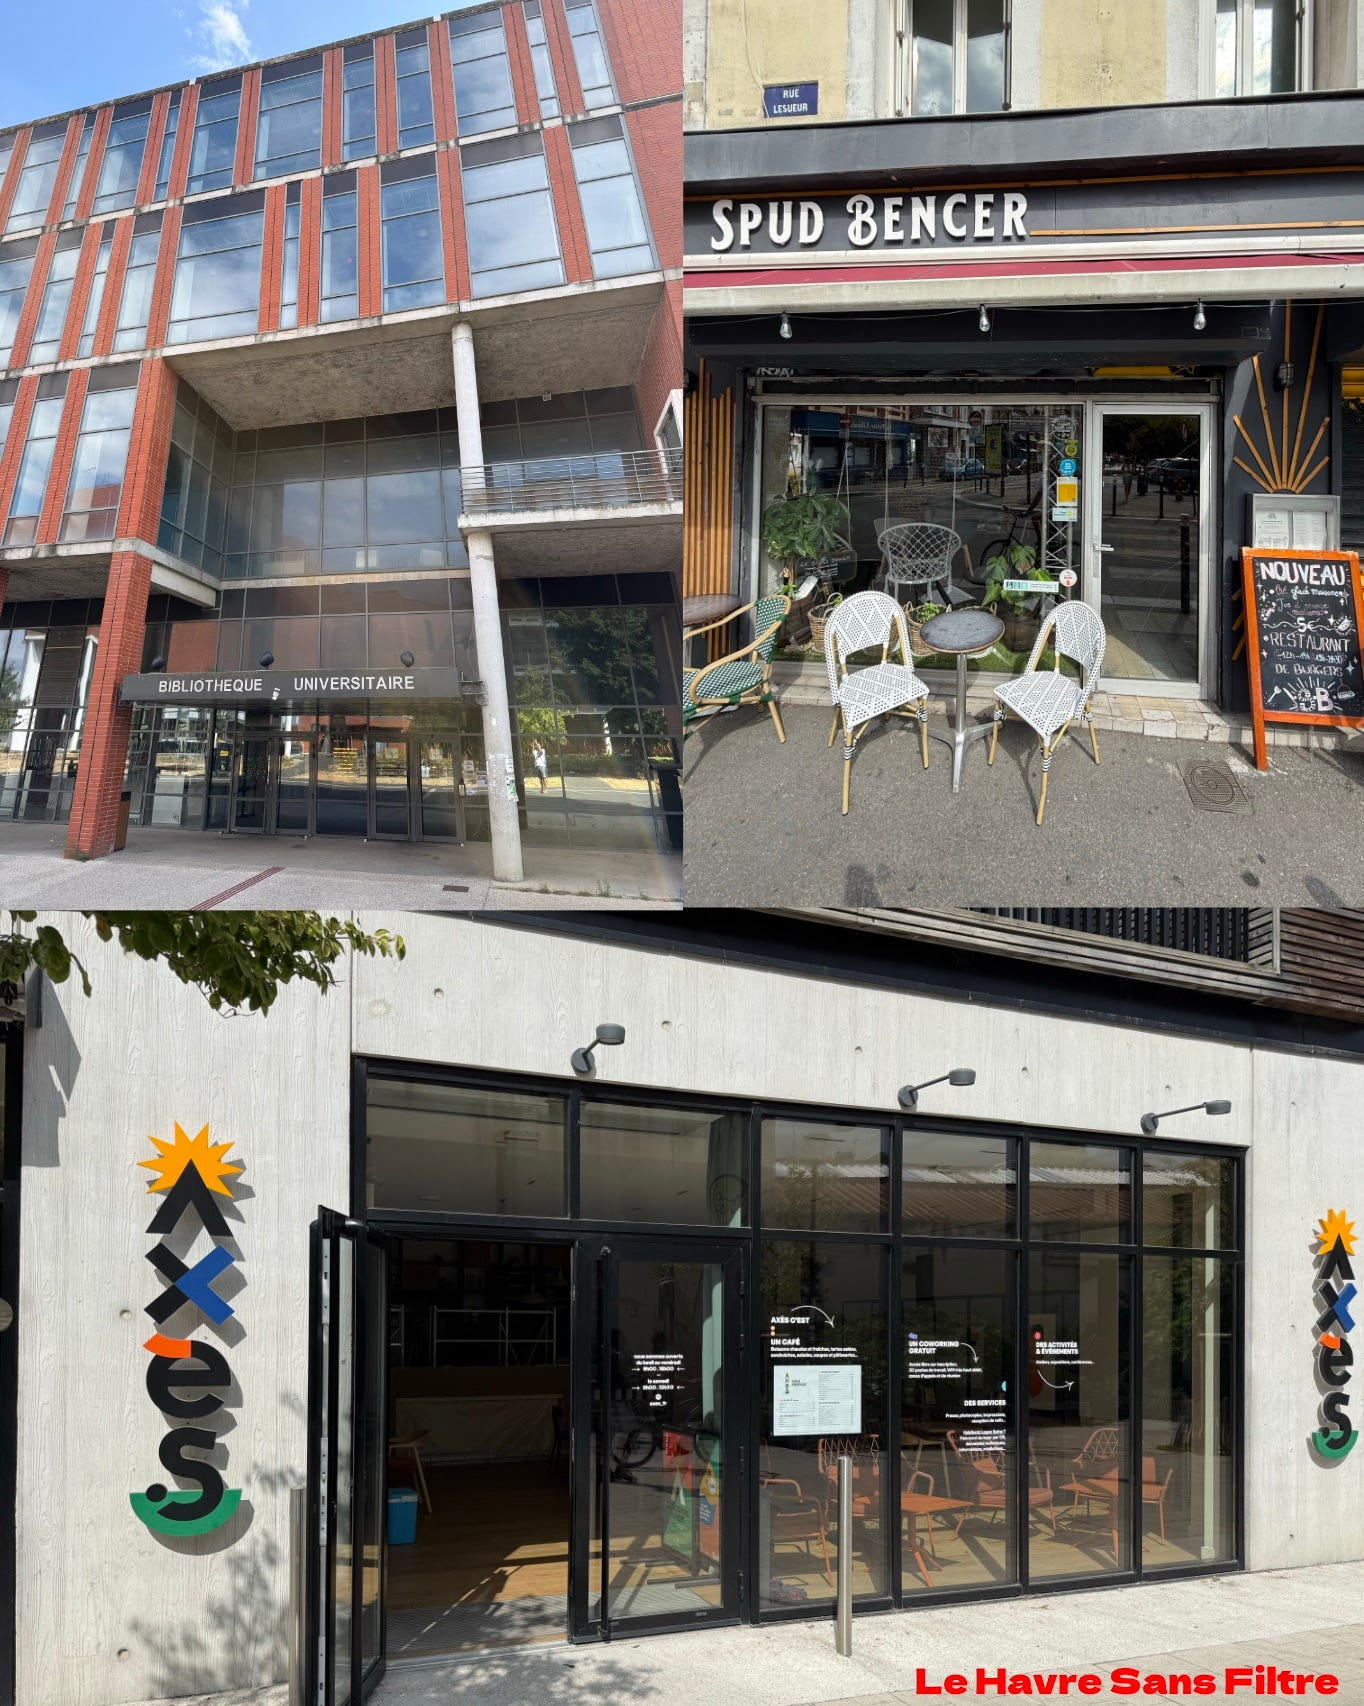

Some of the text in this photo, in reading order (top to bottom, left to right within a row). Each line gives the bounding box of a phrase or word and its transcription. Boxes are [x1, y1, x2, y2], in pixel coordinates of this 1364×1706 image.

[782, 89, 800, 98] RUE
[774, 103, 808, 114] LESUEUR
[711, 192, 1027, 251] SPUD BENCER
[1260, 562, 1345, 585] NOUVEAU
[1270, 632, 1351, 652] RESTAURANT
[1275, 663, 1343, 677] DE BURGERS
[158, 676, 414, 693] BIBLIOTHEQUE UNIVERSITAIRE
[770, 1338, 800, 1346] UN CAFÉ
